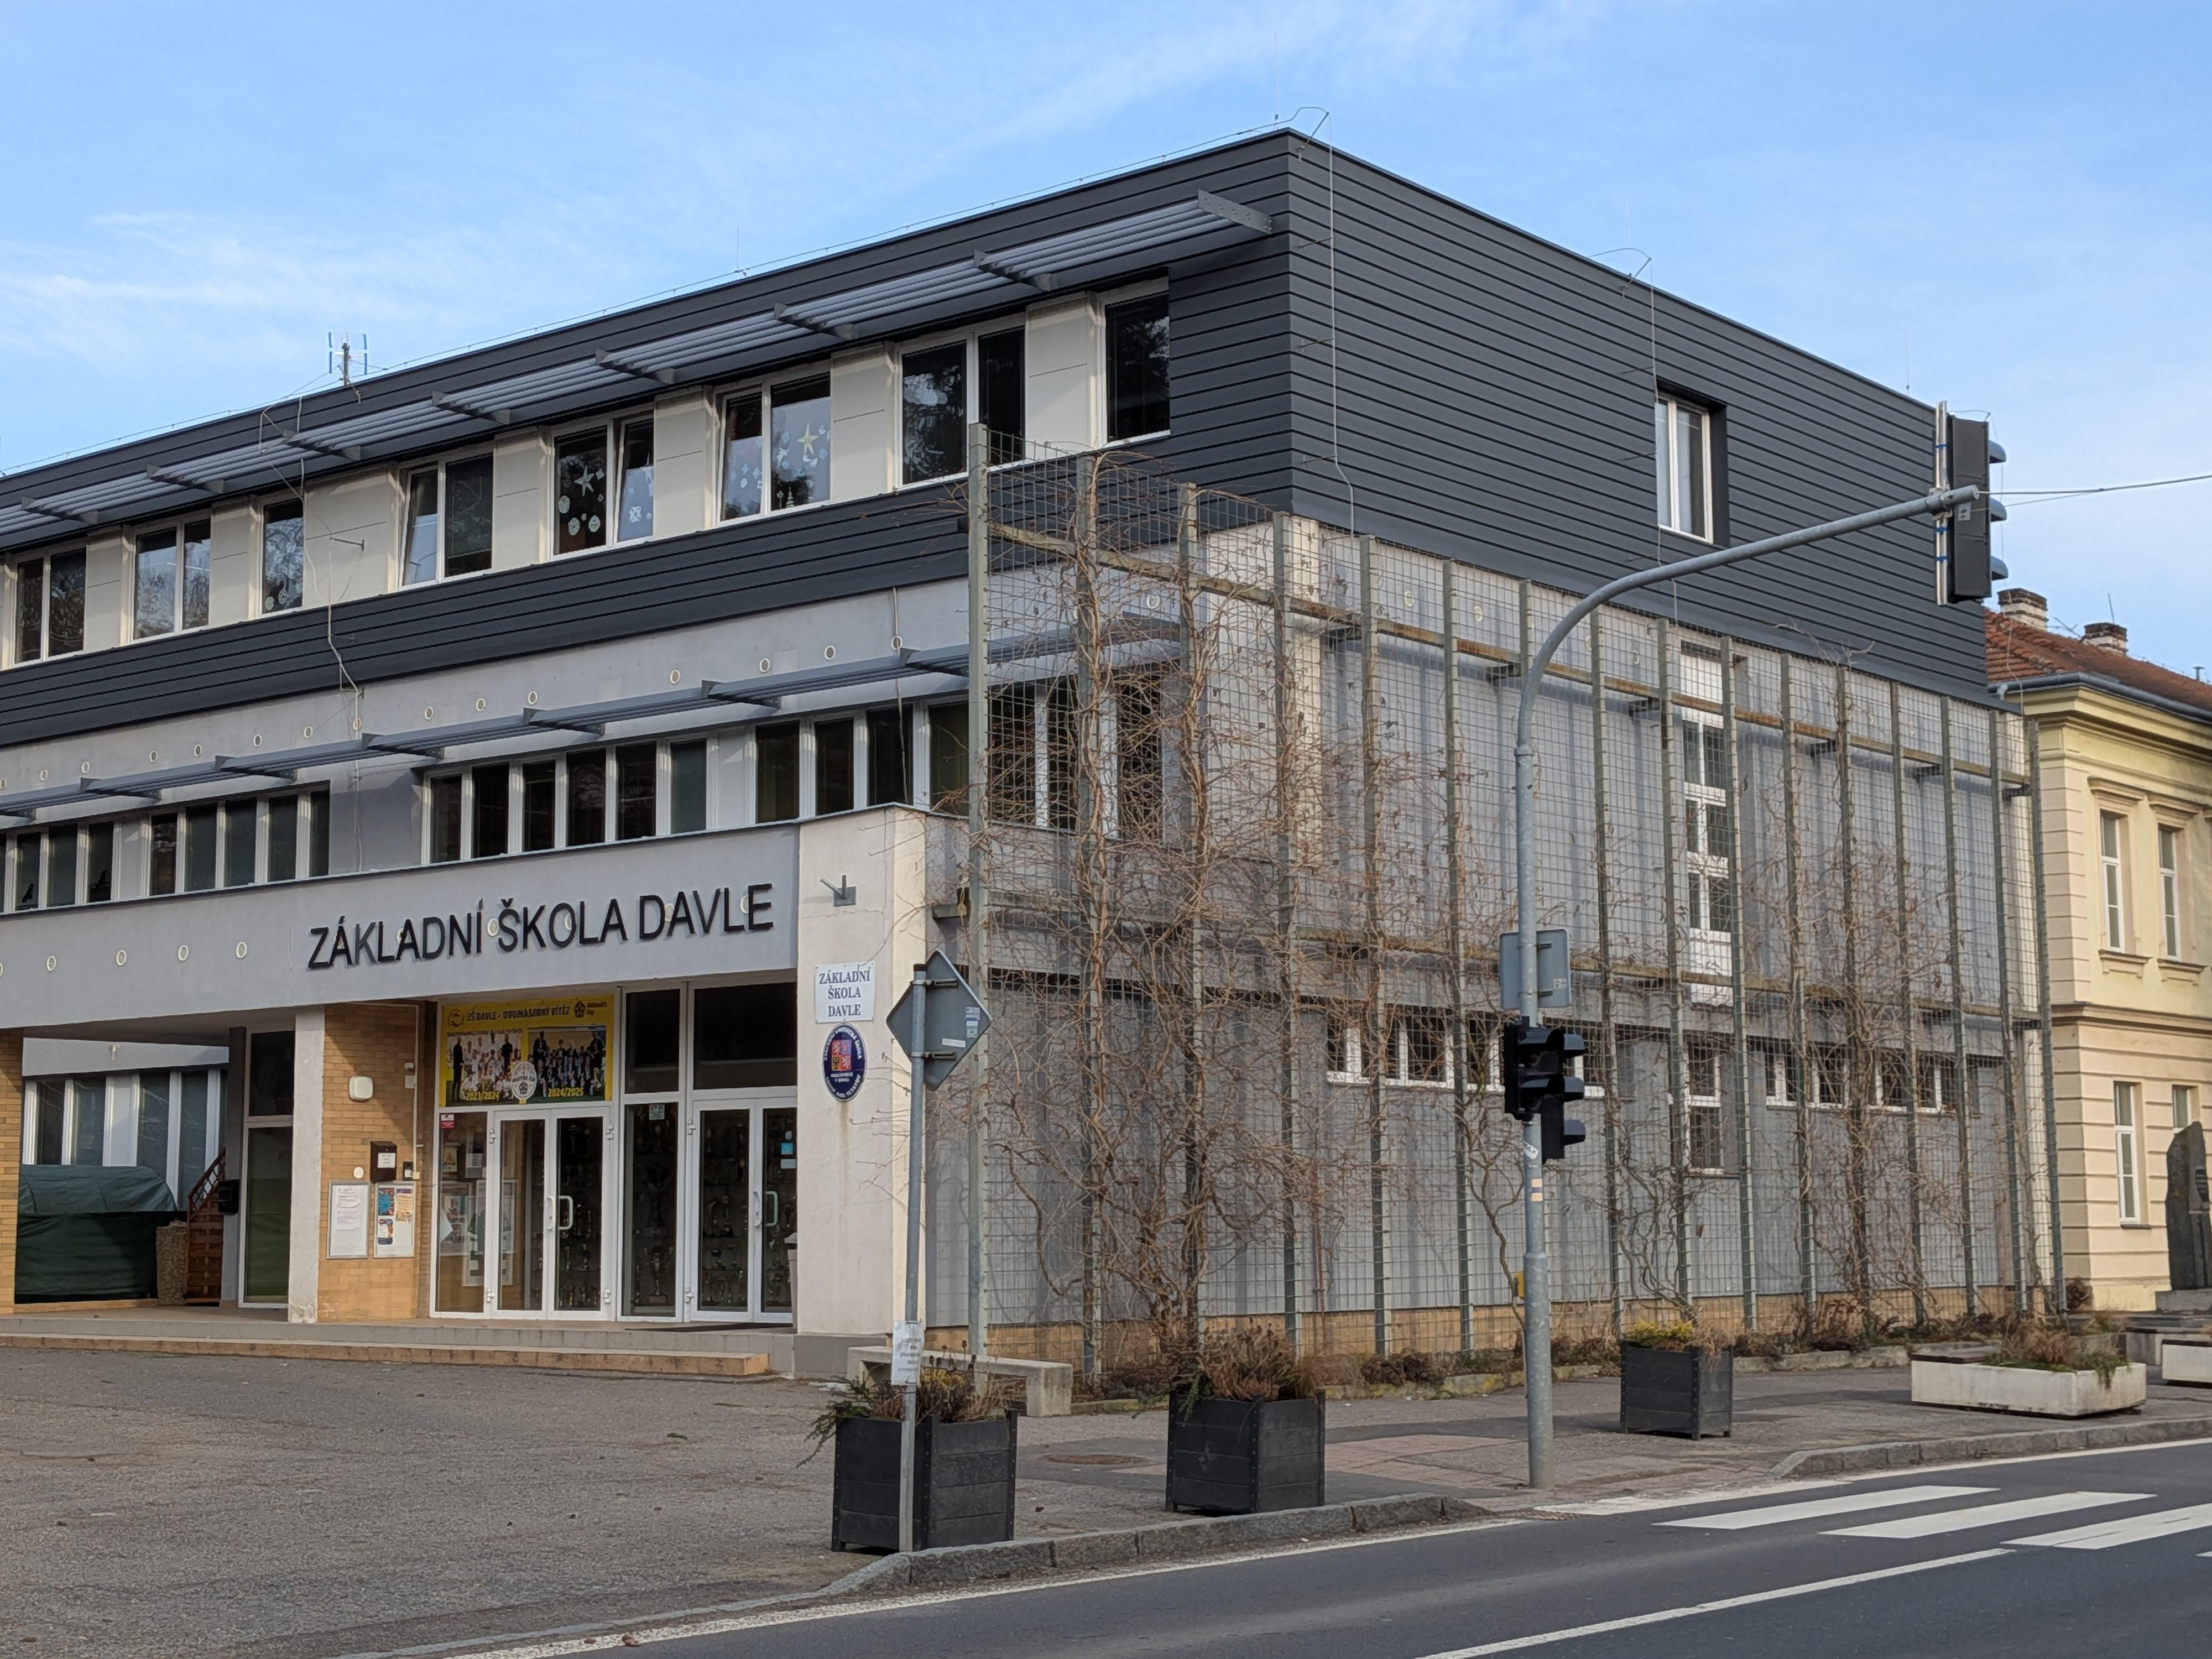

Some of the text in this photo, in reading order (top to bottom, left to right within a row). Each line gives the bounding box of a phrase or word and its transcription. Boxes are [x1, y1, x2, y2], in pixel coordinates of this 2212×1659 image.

[308, 883, 773, 969] ZÁKLADNÍ ŠKOLA DAVLE
[819, 967, 871, 984] ZÁKLADNÍ
[828, 985, 861, 999] ŠKOLA
[828, 1004, 861, 1017] DAVLE
